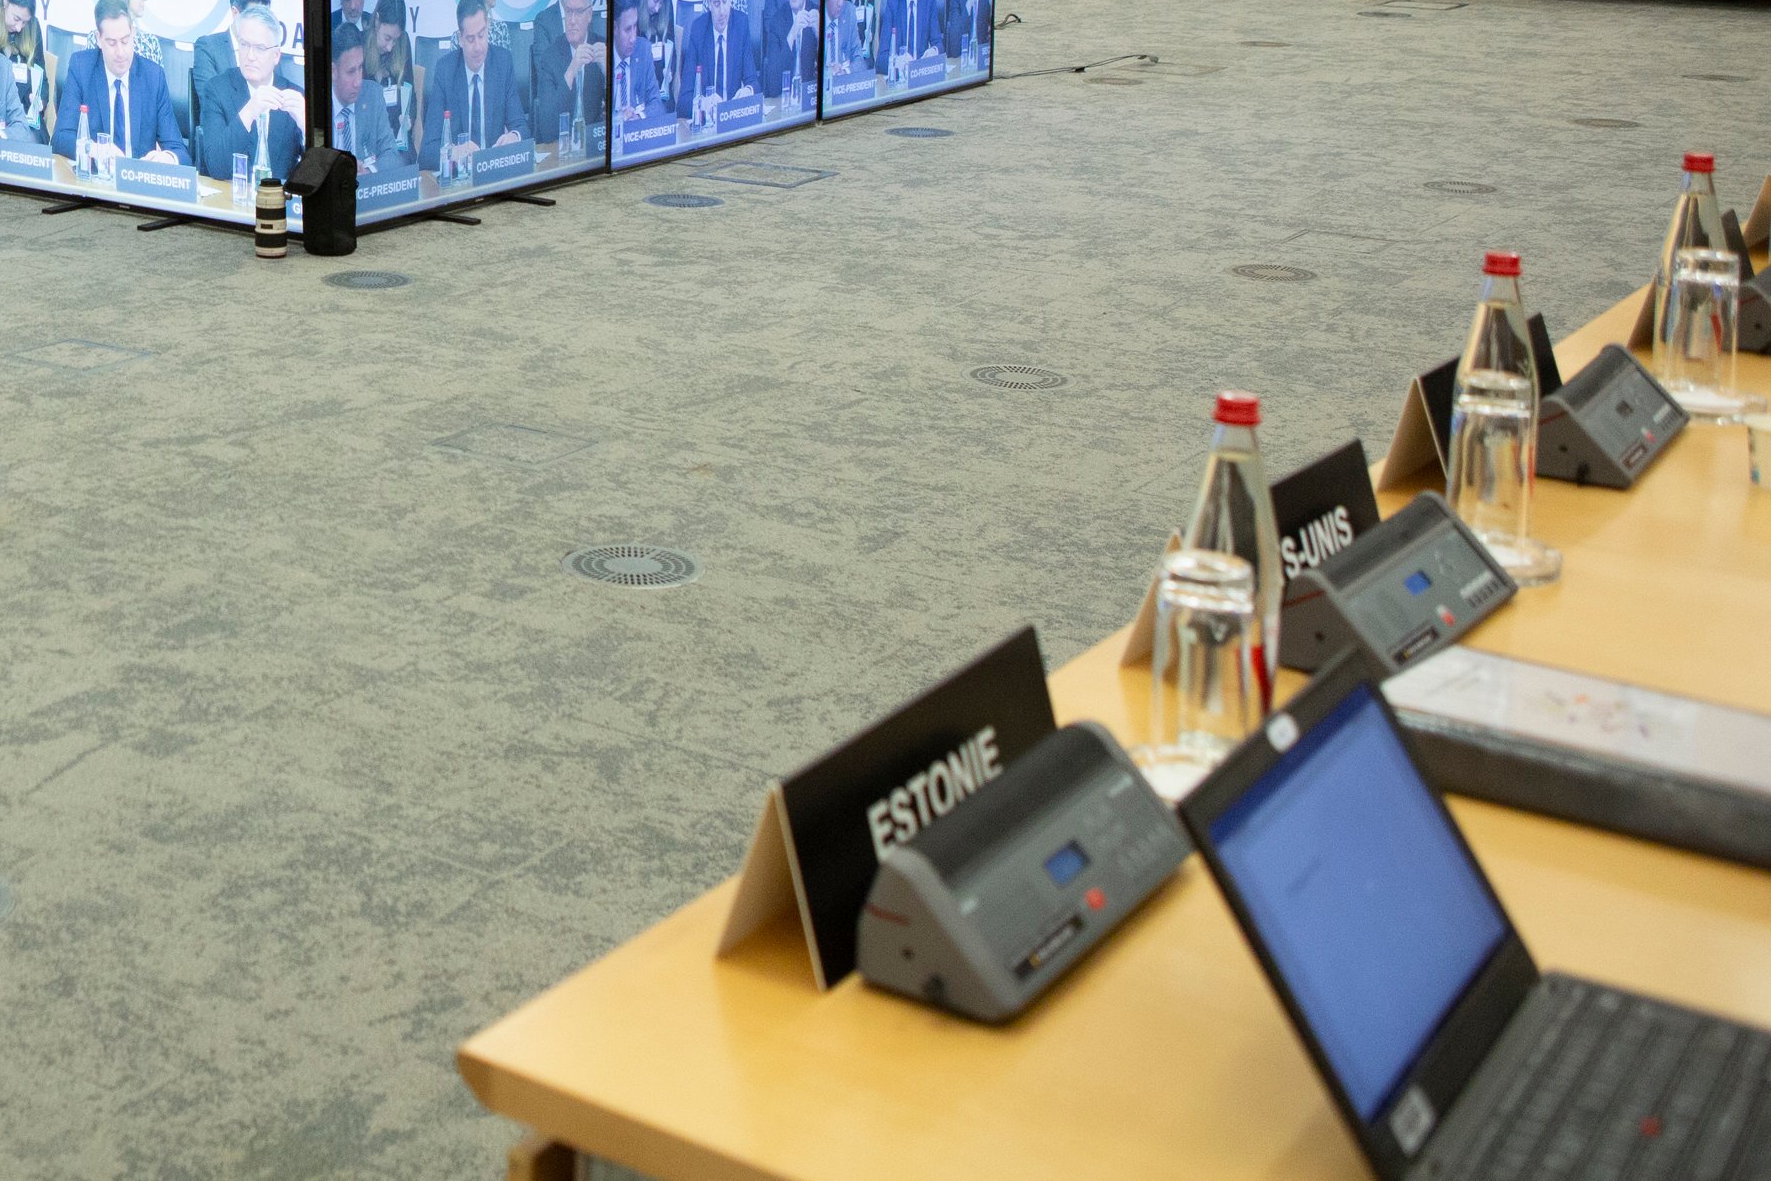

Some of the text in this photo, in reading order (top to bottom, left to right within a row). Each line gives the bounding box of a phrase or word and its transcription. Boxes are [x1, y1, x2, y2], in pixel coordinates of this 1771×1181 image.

[910, 62, 944, 79] CO-PRESIDENT
[832, 79, 876, 96] VICE-PRESIDENT
[720, 105, 760, 122] CO-PRESIDENT
[624, 125, 675, 143] VICE-PRESIDENT
[476, 151, 530, 173] CO-PRESIDENT
[121, 169, 191, 190] CO-PRESIDENT
[357, 182, 417, 200] CE-PRESIDENT
[1280, 504, 1353, 579] S-UNIS
[866, 725, 1004, 861] ESTONIE
